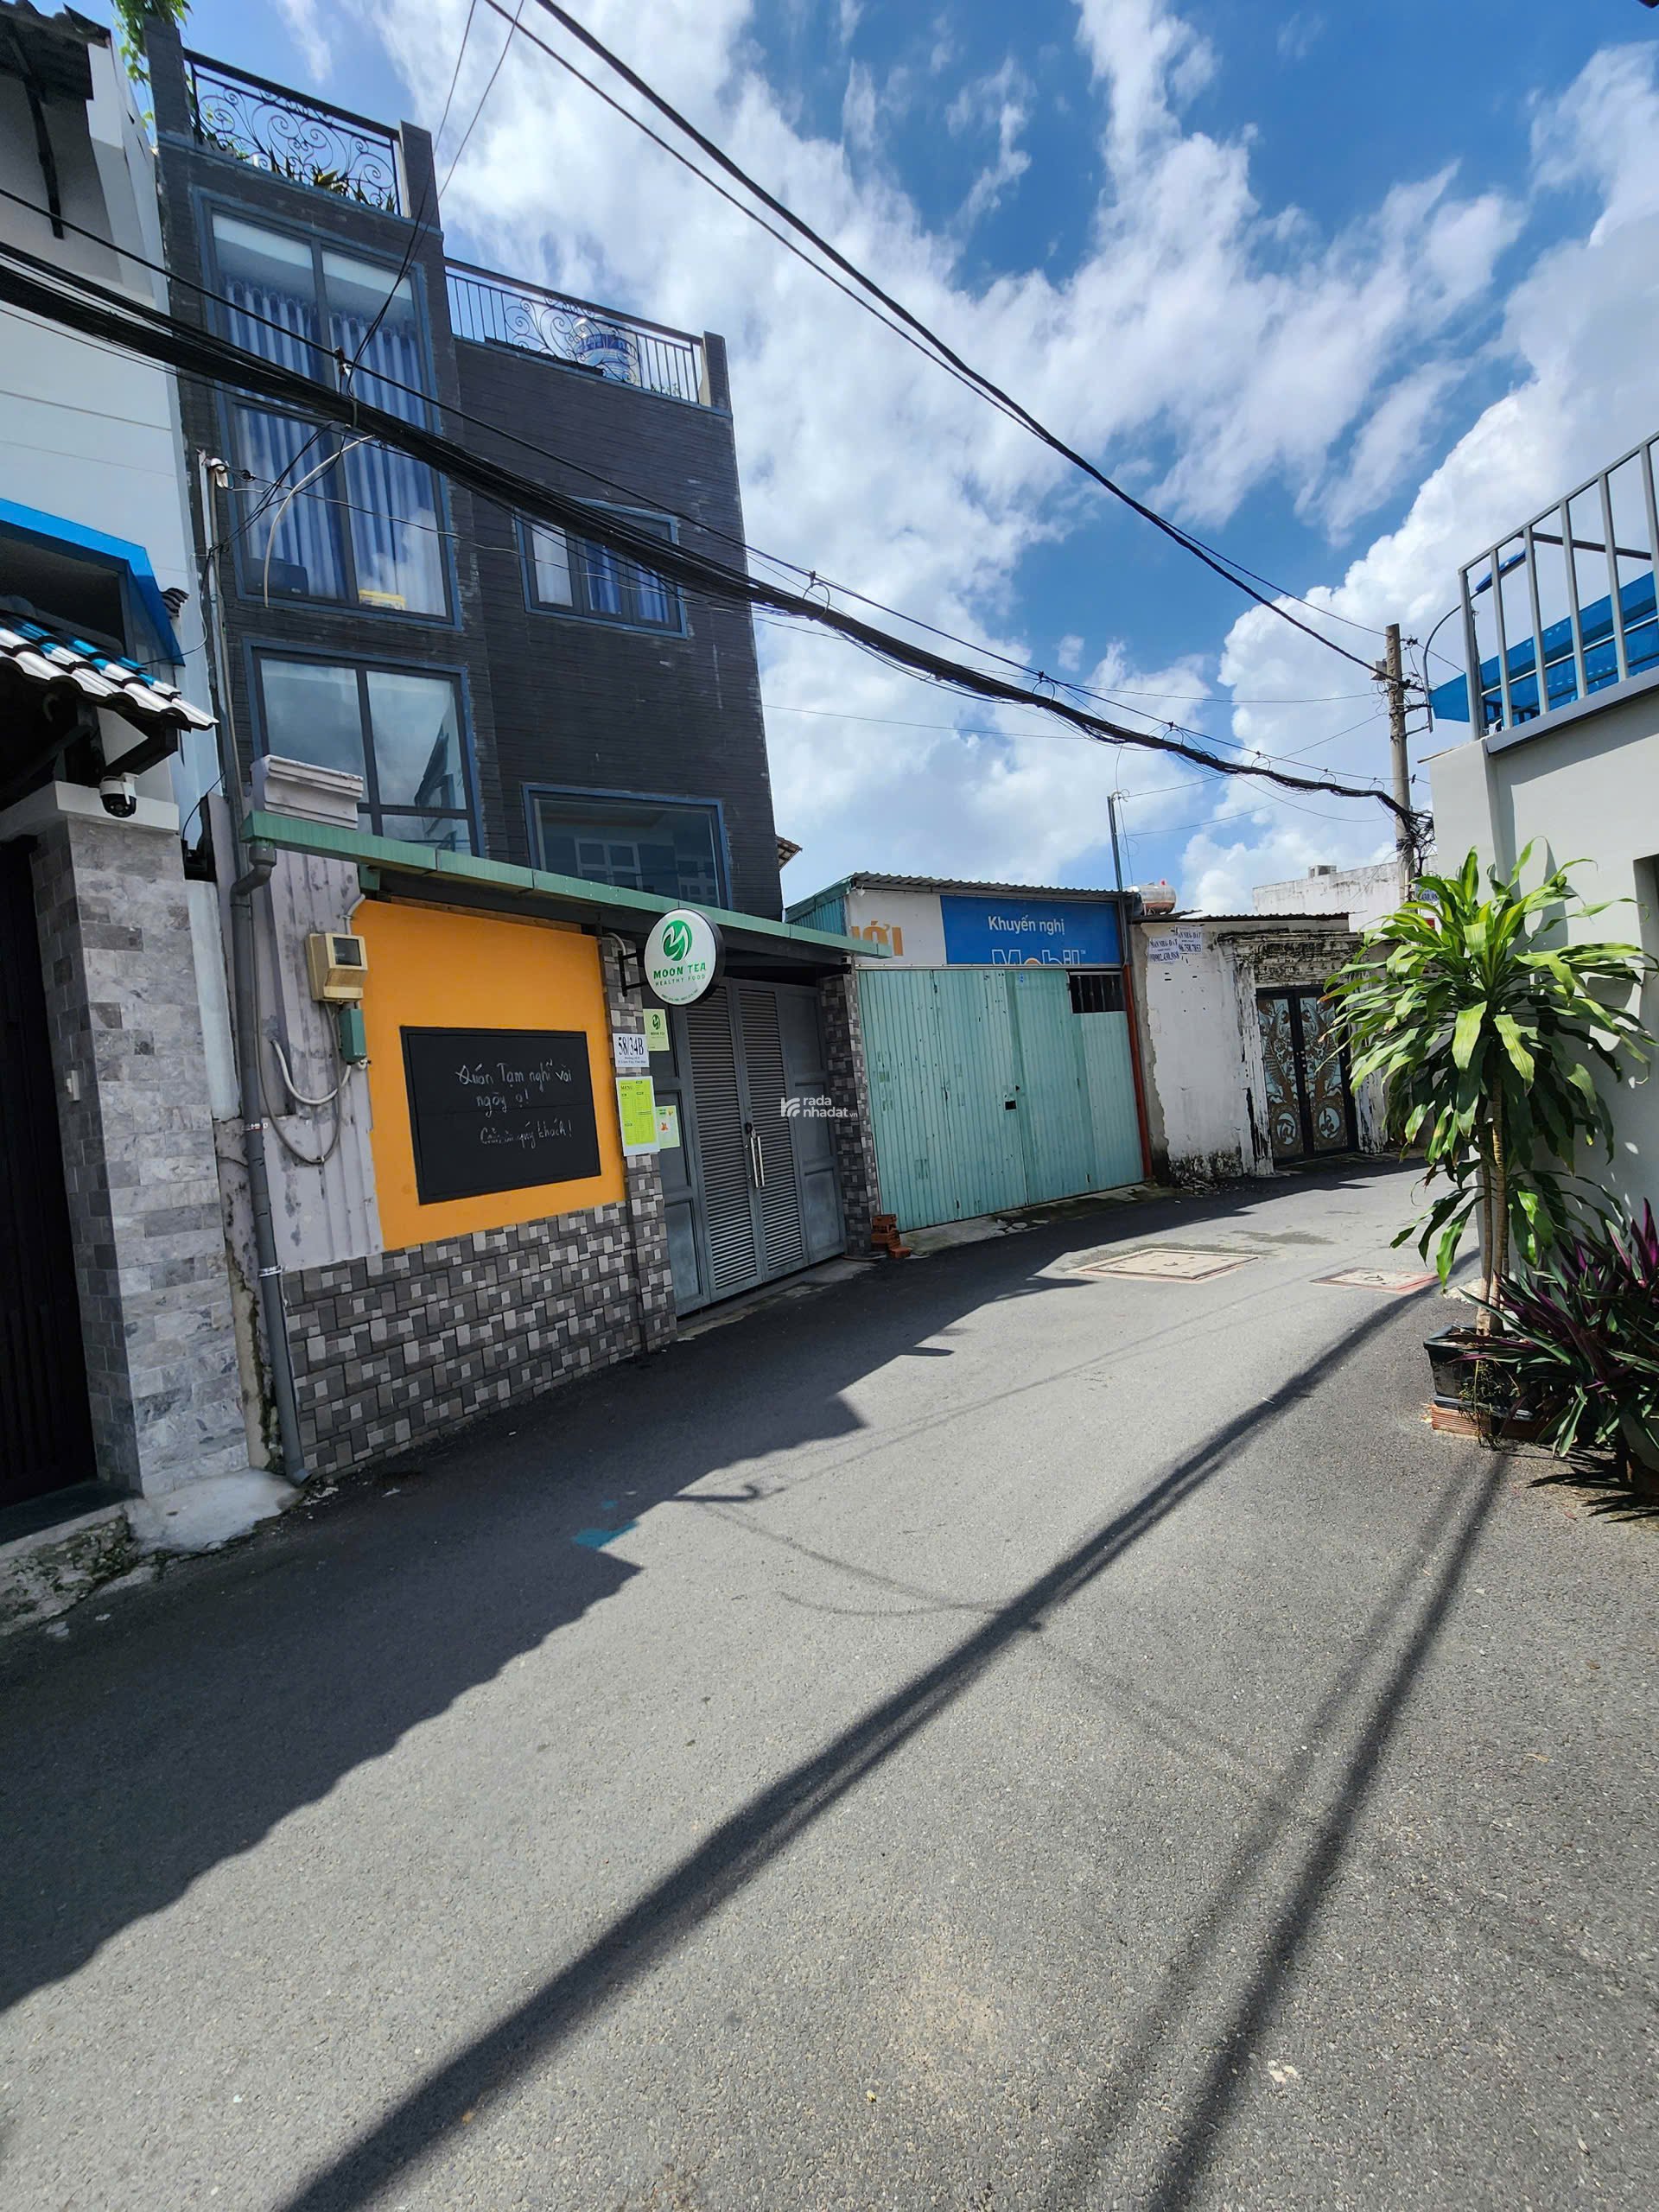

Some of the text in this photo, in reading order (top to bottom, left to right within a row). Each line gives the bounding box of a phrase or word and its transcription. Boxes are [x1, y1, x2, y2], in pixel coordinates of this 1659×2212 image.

[988, 914, 1065, 935] Khuyến nghị
[653, 963, 706, 979] MOON TEA
[655, 977, 684, 986] HEALTHY
[618, 1036, 644, 1055] 58/34B
[455, 1063, 493, 1084] Quán
